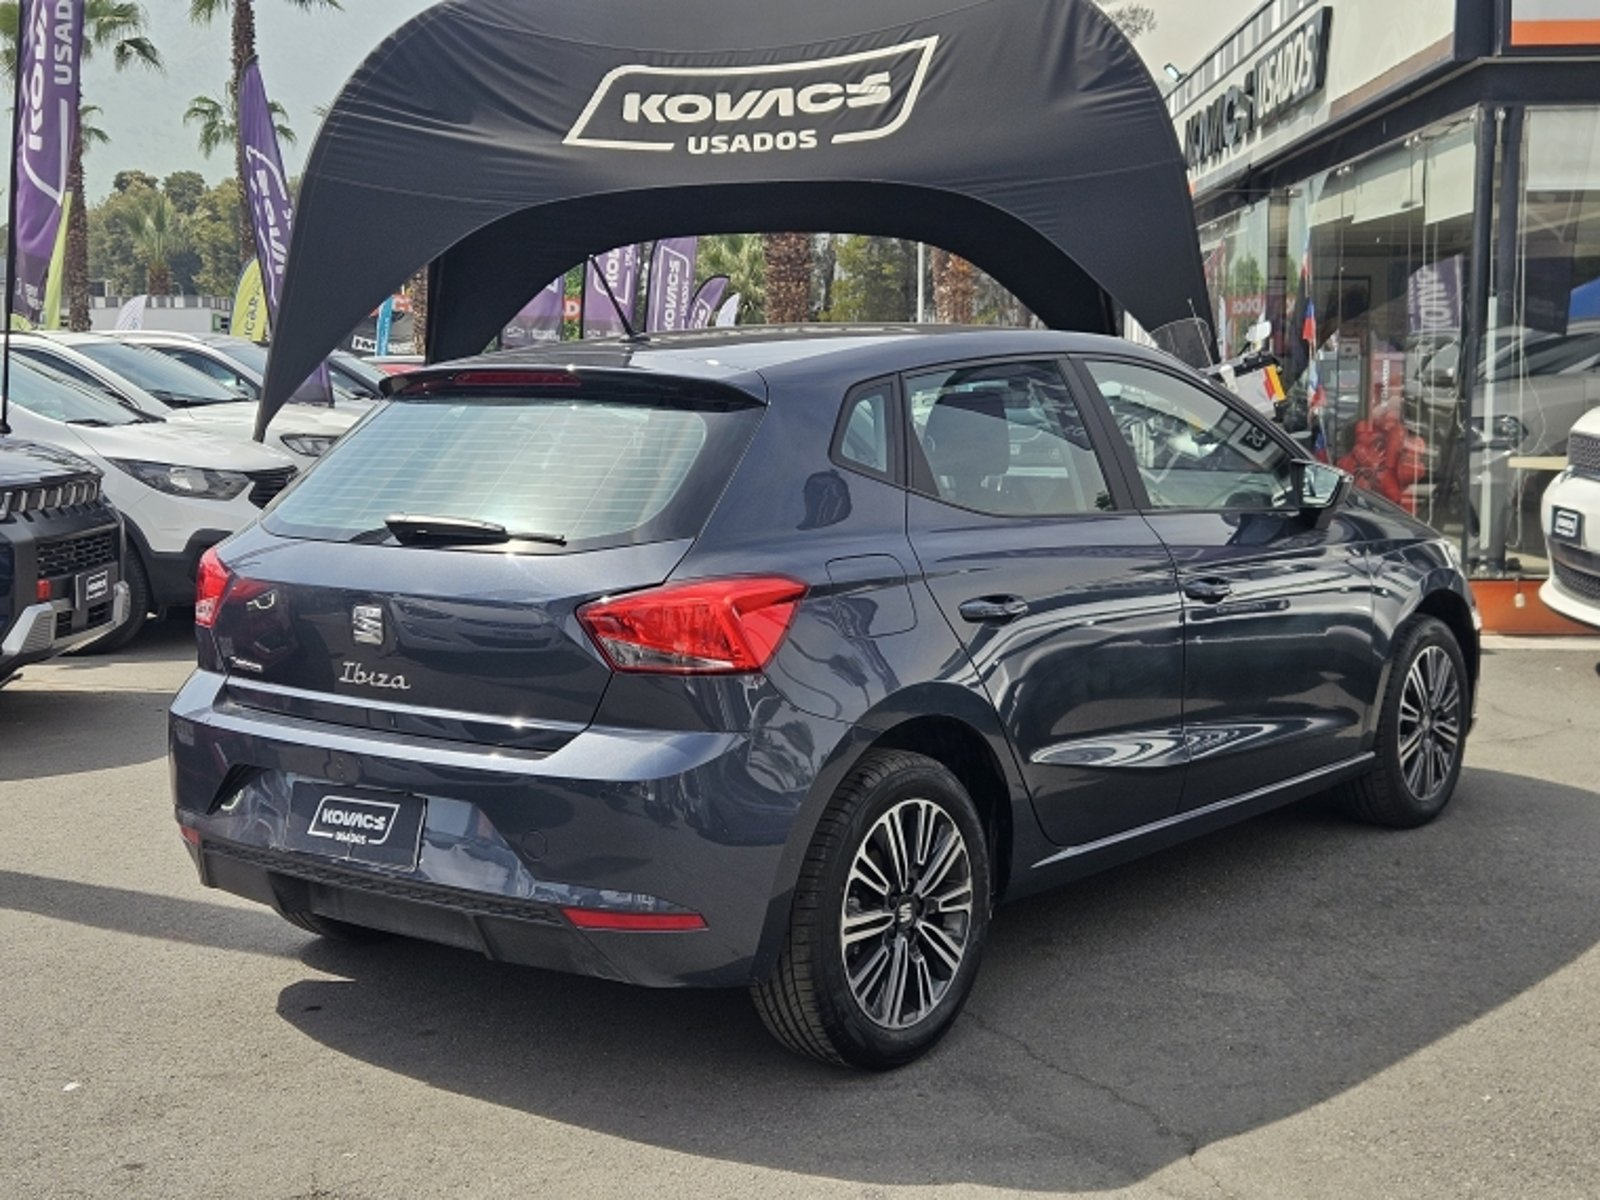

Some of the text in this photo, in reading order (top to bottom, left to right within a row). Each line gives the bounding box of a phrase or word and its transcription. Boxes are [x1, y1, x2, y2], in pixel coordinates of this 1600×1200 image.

[1257, 22, 1318, 120] USADOS
[622, 71, 892, 124] KOVACS
[687, 129, 818, 155] USADOS
[339, 661, 412, 690] Ibiza
[321, 807, 387, 832] KOVACS
